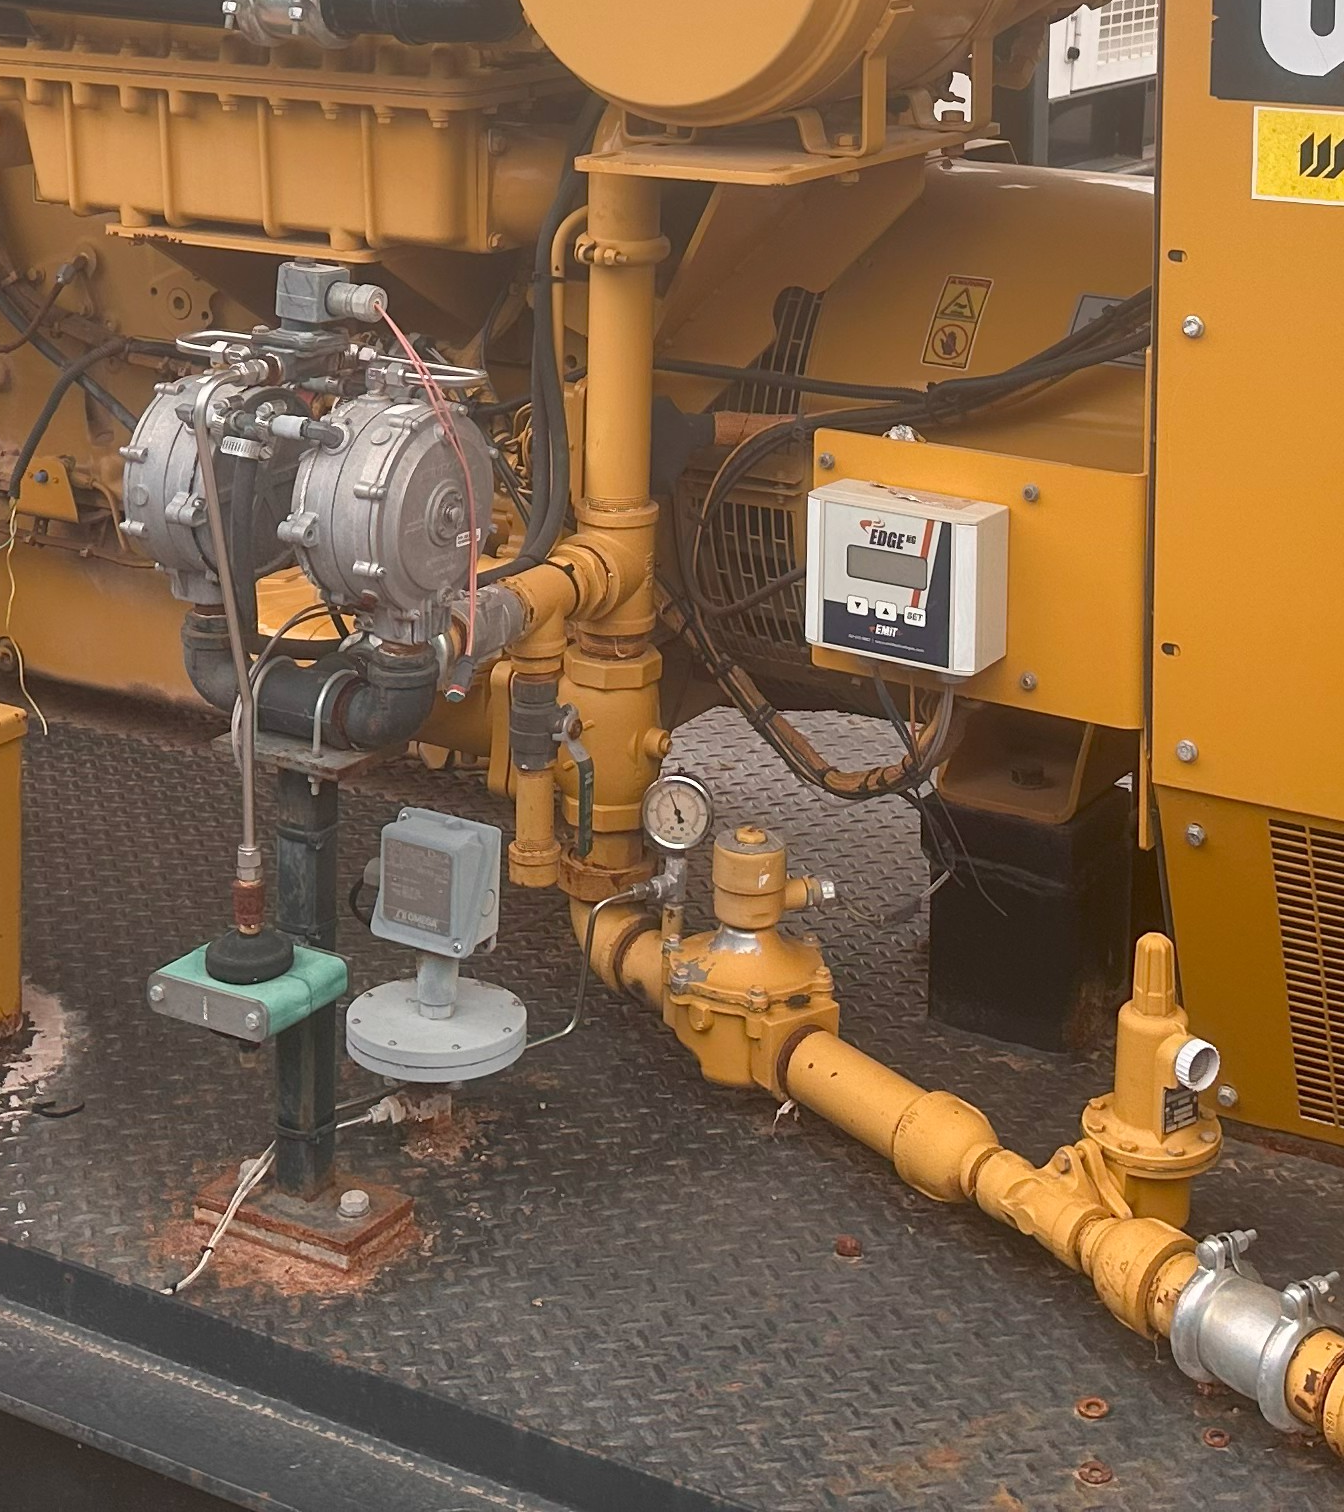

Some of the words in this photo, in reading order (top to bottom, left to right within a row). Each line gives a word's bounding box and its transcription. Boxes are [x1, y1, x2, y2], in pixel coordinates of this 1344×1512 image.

[869, 528, 906, 550] EDGE
[906, 611, 923, 621] SET
[875, 623, 899, 637] EMIT
